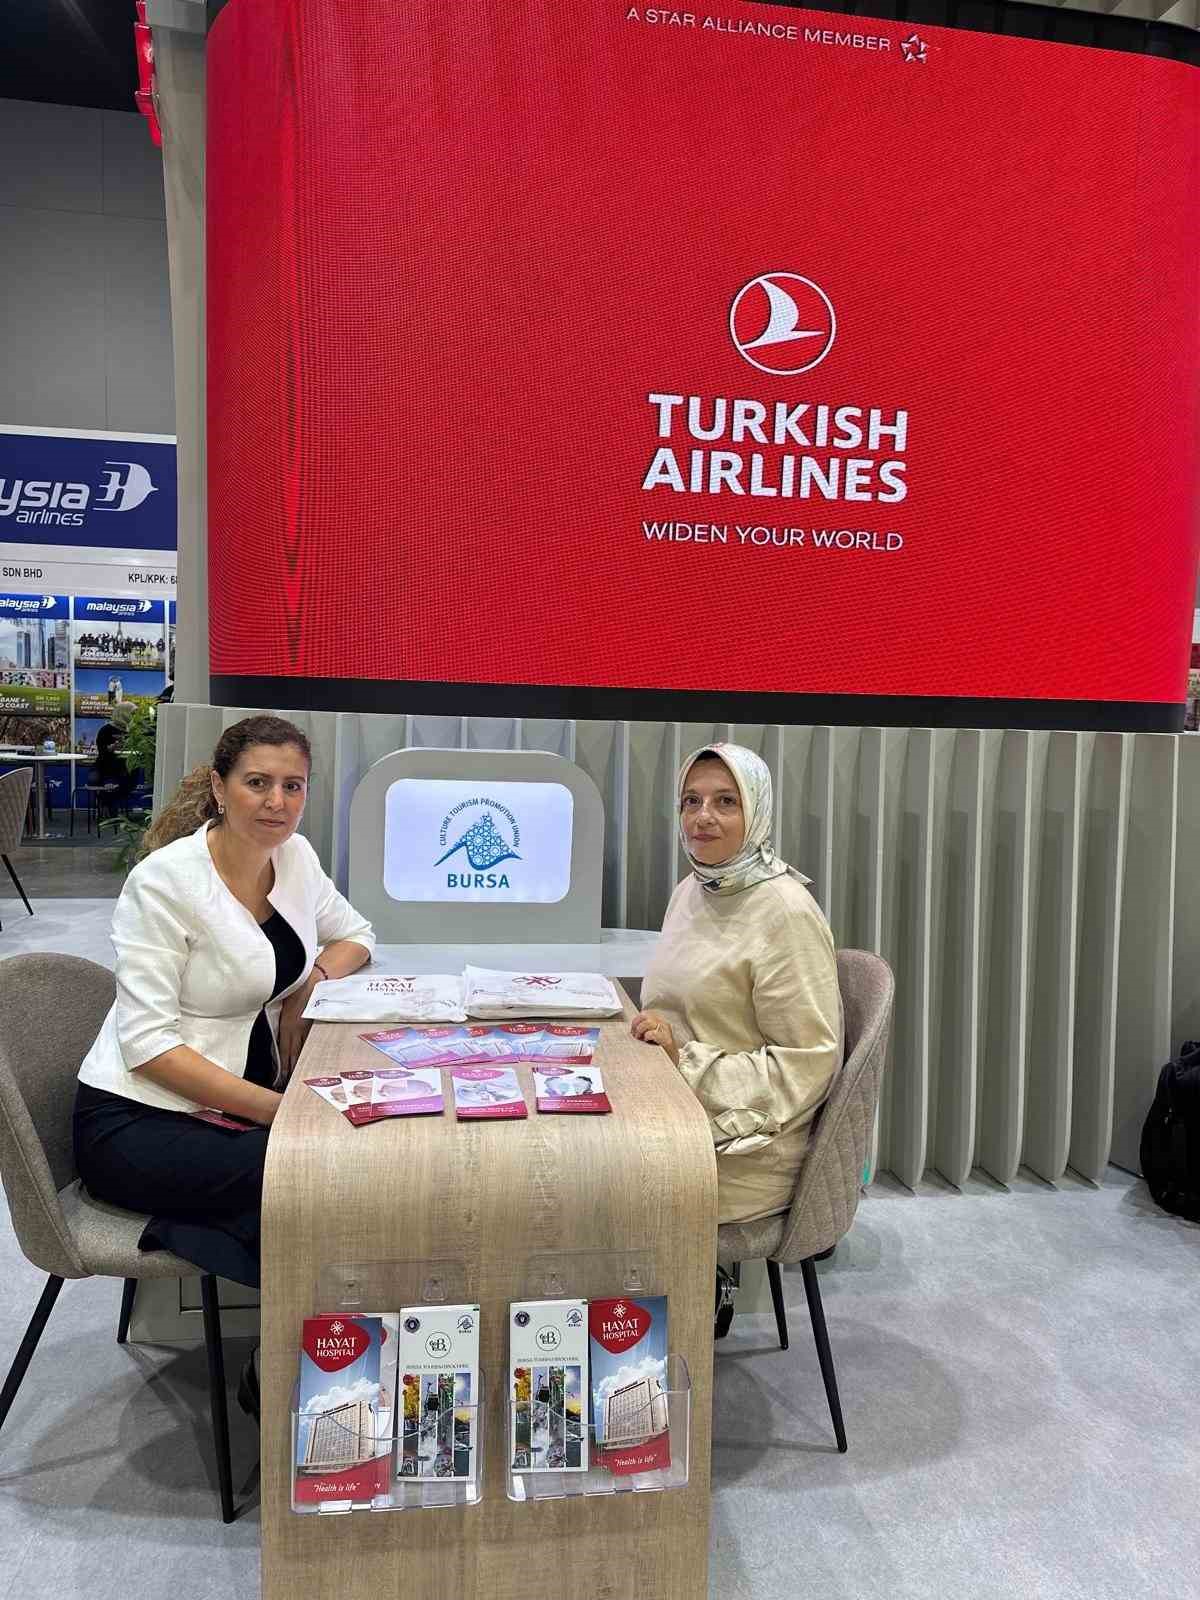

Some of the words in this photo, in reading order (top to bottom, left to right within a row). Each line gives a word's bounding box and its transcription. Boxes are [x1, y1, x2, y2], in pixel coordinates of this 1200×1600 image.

[626, 7, 640, 21] A
[645, 9, 695, 28] STAR
[702, 17, 798, 40] ALLIANCE
[804, 28, 891, 51] MEMBER
[648, 393, 908, 452] TURKISH
[641, 447, 908, 504] AIRLINES
[16, 508, 85, 526] airlines
[642, 521, 727, 543] WIDEN
[735, 526, 804, 547] YOUR
[812, 530, 904, 551] WORLD
[2, 567, 21, 577] SDN
[23, 568, 43, 579] BHD
[86, 602, 136, 614] malaysia
[450, 798, 479, 817] TOURISM
[480, 798, 516, 824] PROMOTION
[447, 873, 510, 888] BURSA
[602, 1318, 640, 1332] HAYAT
[603, 1329, 639, 1341] HOSPITAL
[317, 1337, 357, 1349] HAYAT
[316, 1348, 355, 1357] HOSPITAL
